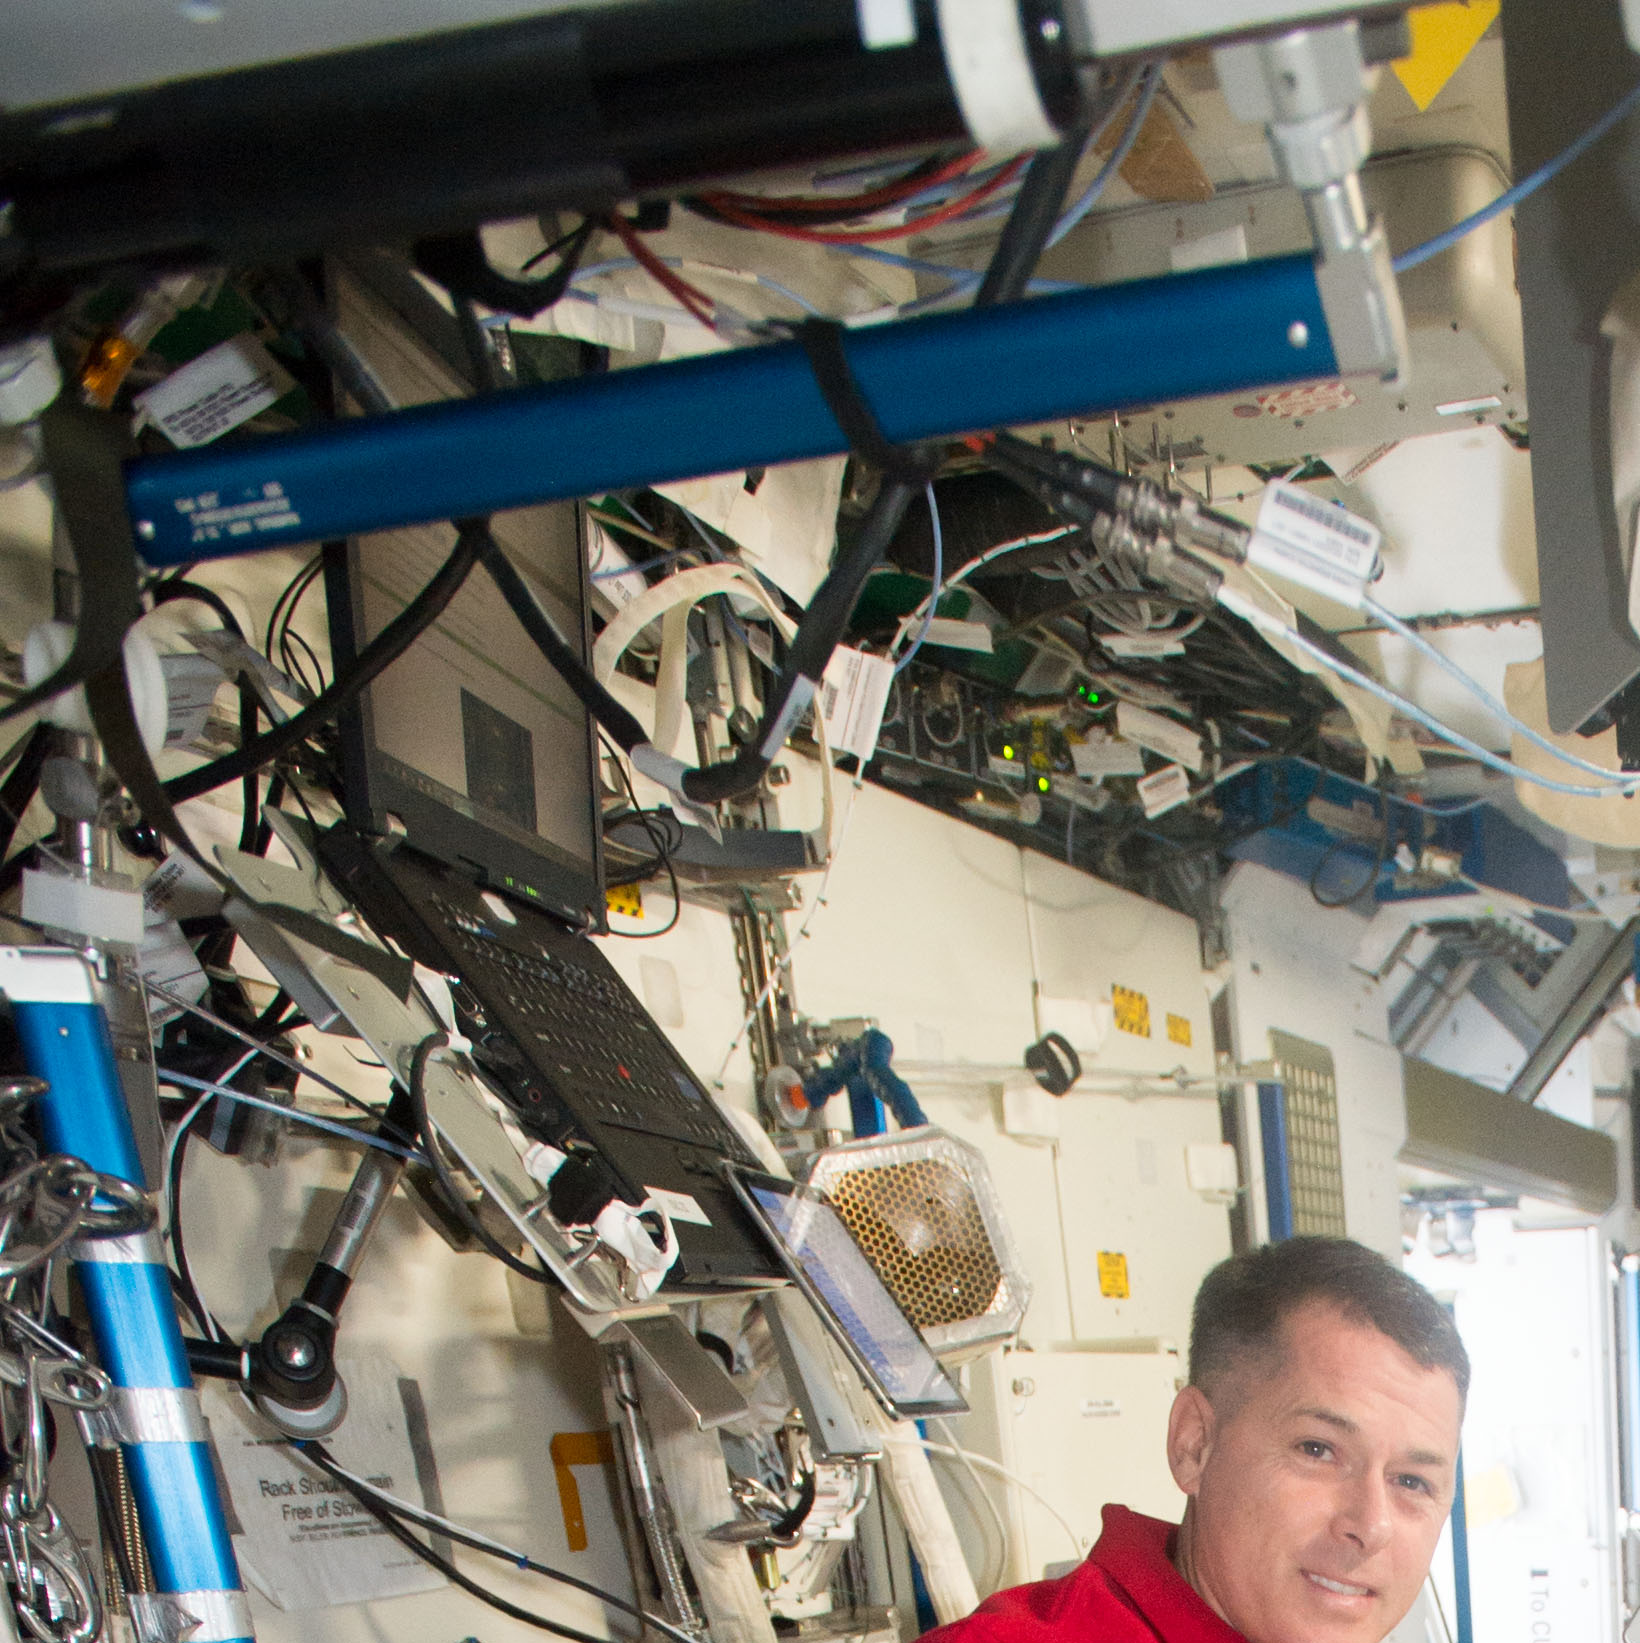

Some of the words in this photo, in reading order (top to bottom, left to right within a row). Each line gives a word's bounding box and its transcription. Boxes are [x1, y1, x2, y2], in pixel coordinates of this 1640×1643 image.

[259, 1478, 297, 1498] Rack
[300, 1476, 352, 1495] Shoul
[282, 1503, 314, 1521] Free
[316, 1500, 329, 1518] of
[1531, 1587, 1549, 1613] To
